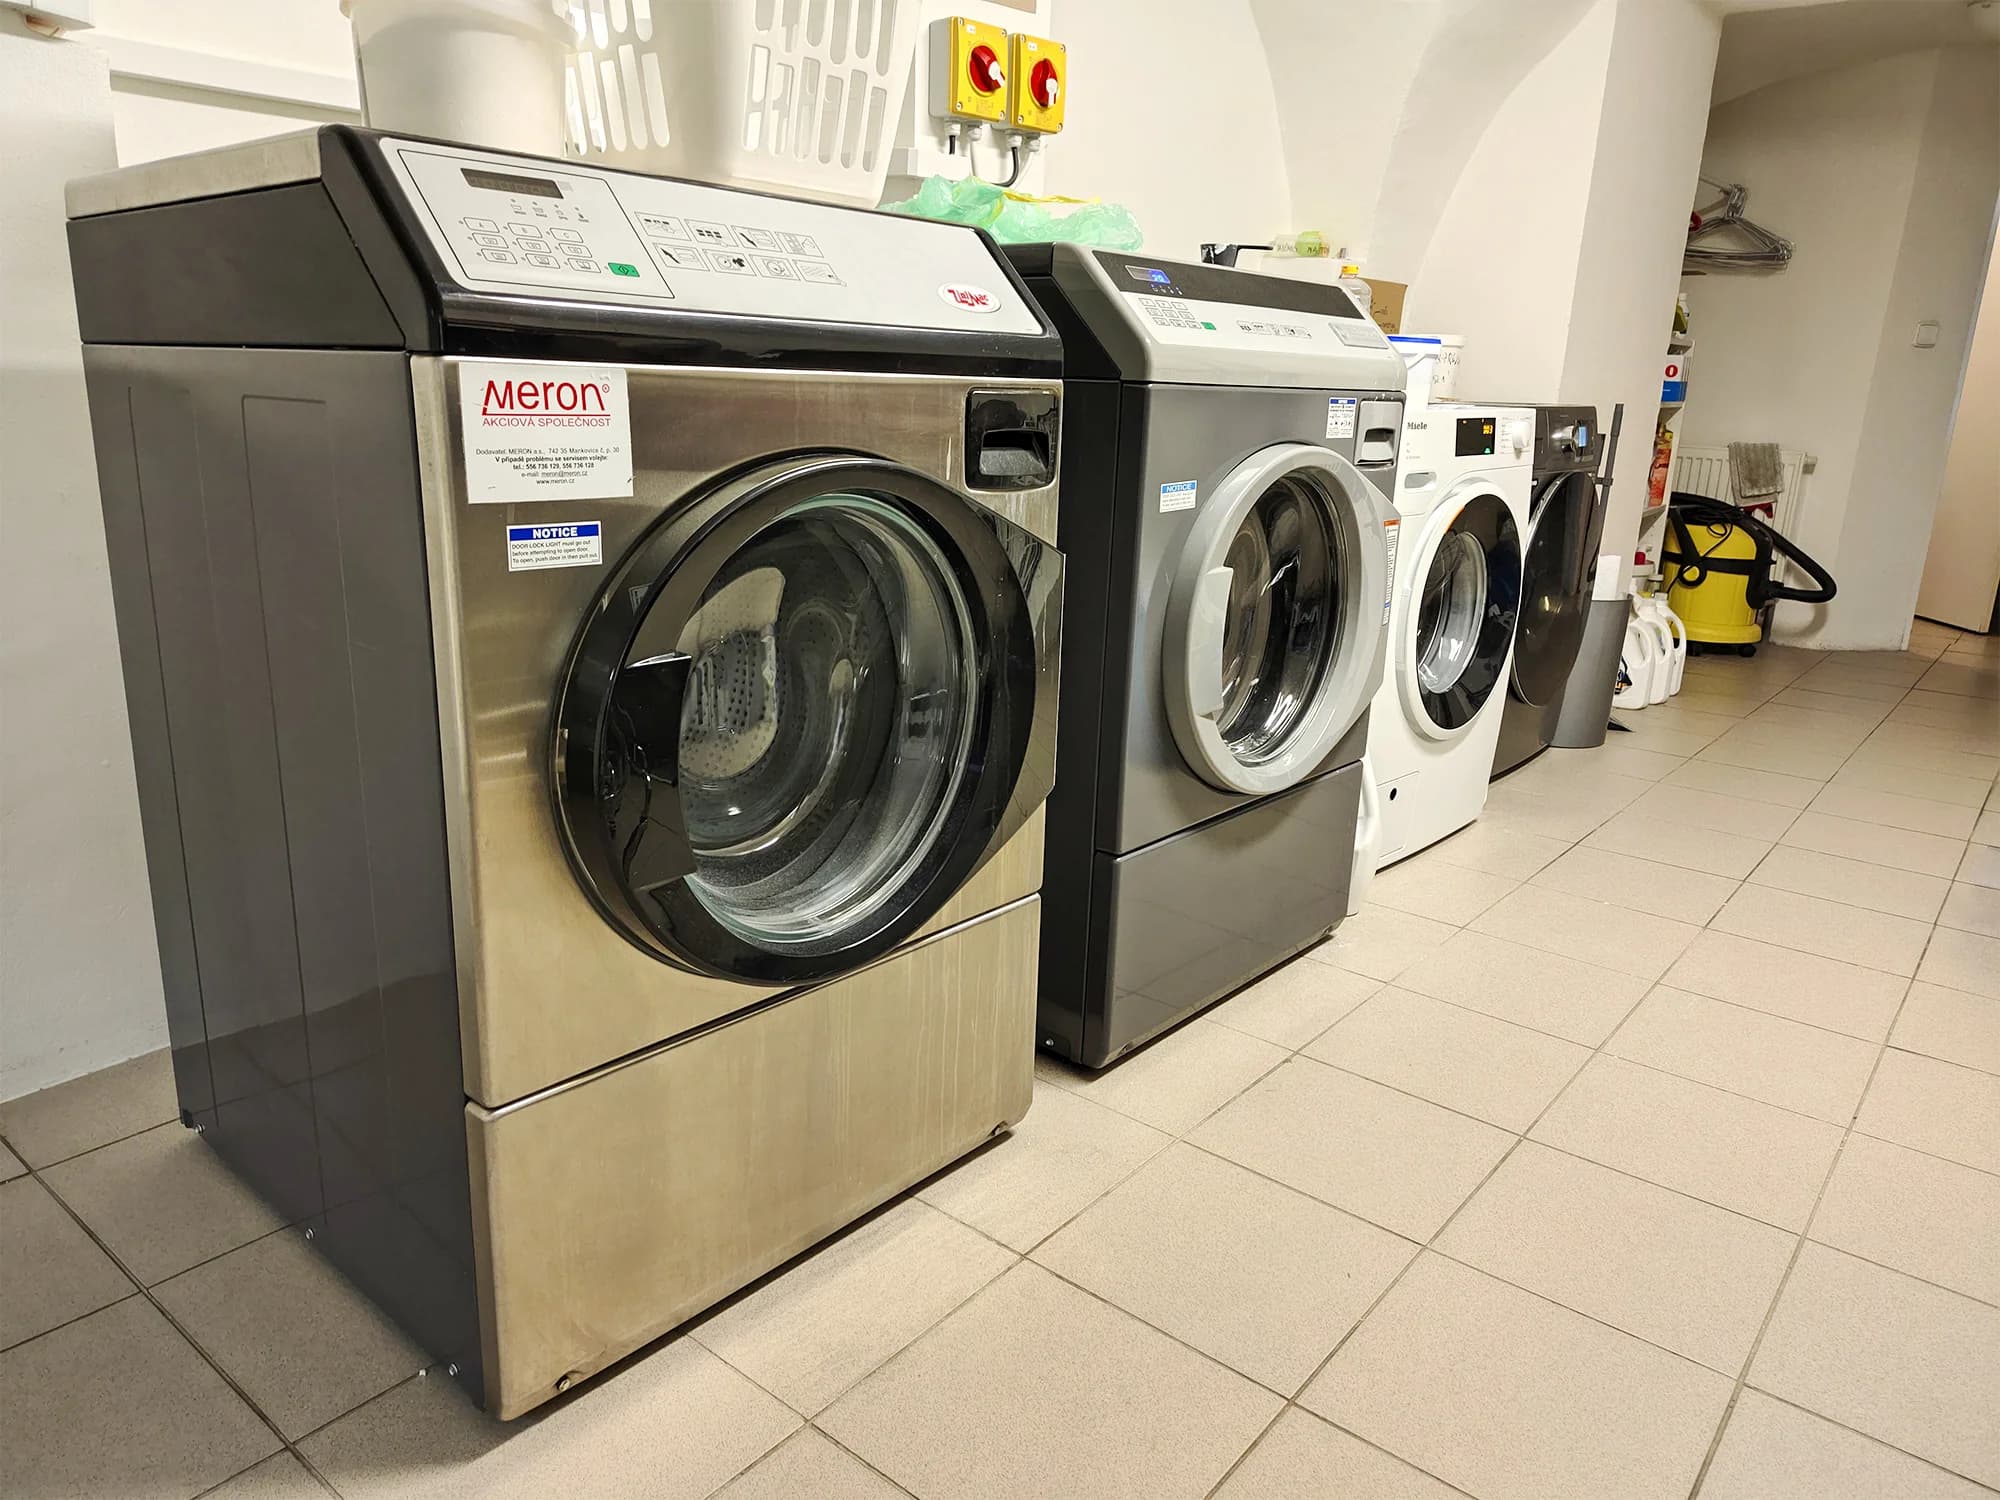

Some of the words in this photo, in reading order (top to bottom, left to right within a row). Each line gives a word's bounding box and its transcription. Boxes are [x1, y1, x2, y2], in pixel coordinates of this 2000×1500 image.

[482, 417, 535, 427] AKCIOVÁ
[538, 416, 611, 427] SPOLEČNOST
[1407, 422, 1427, 430] Miele
[526, 455, 554, 463] problému
[1166, 483, 1191, 493] NOTICE
[532, 527, 578, 539] NOTICE
